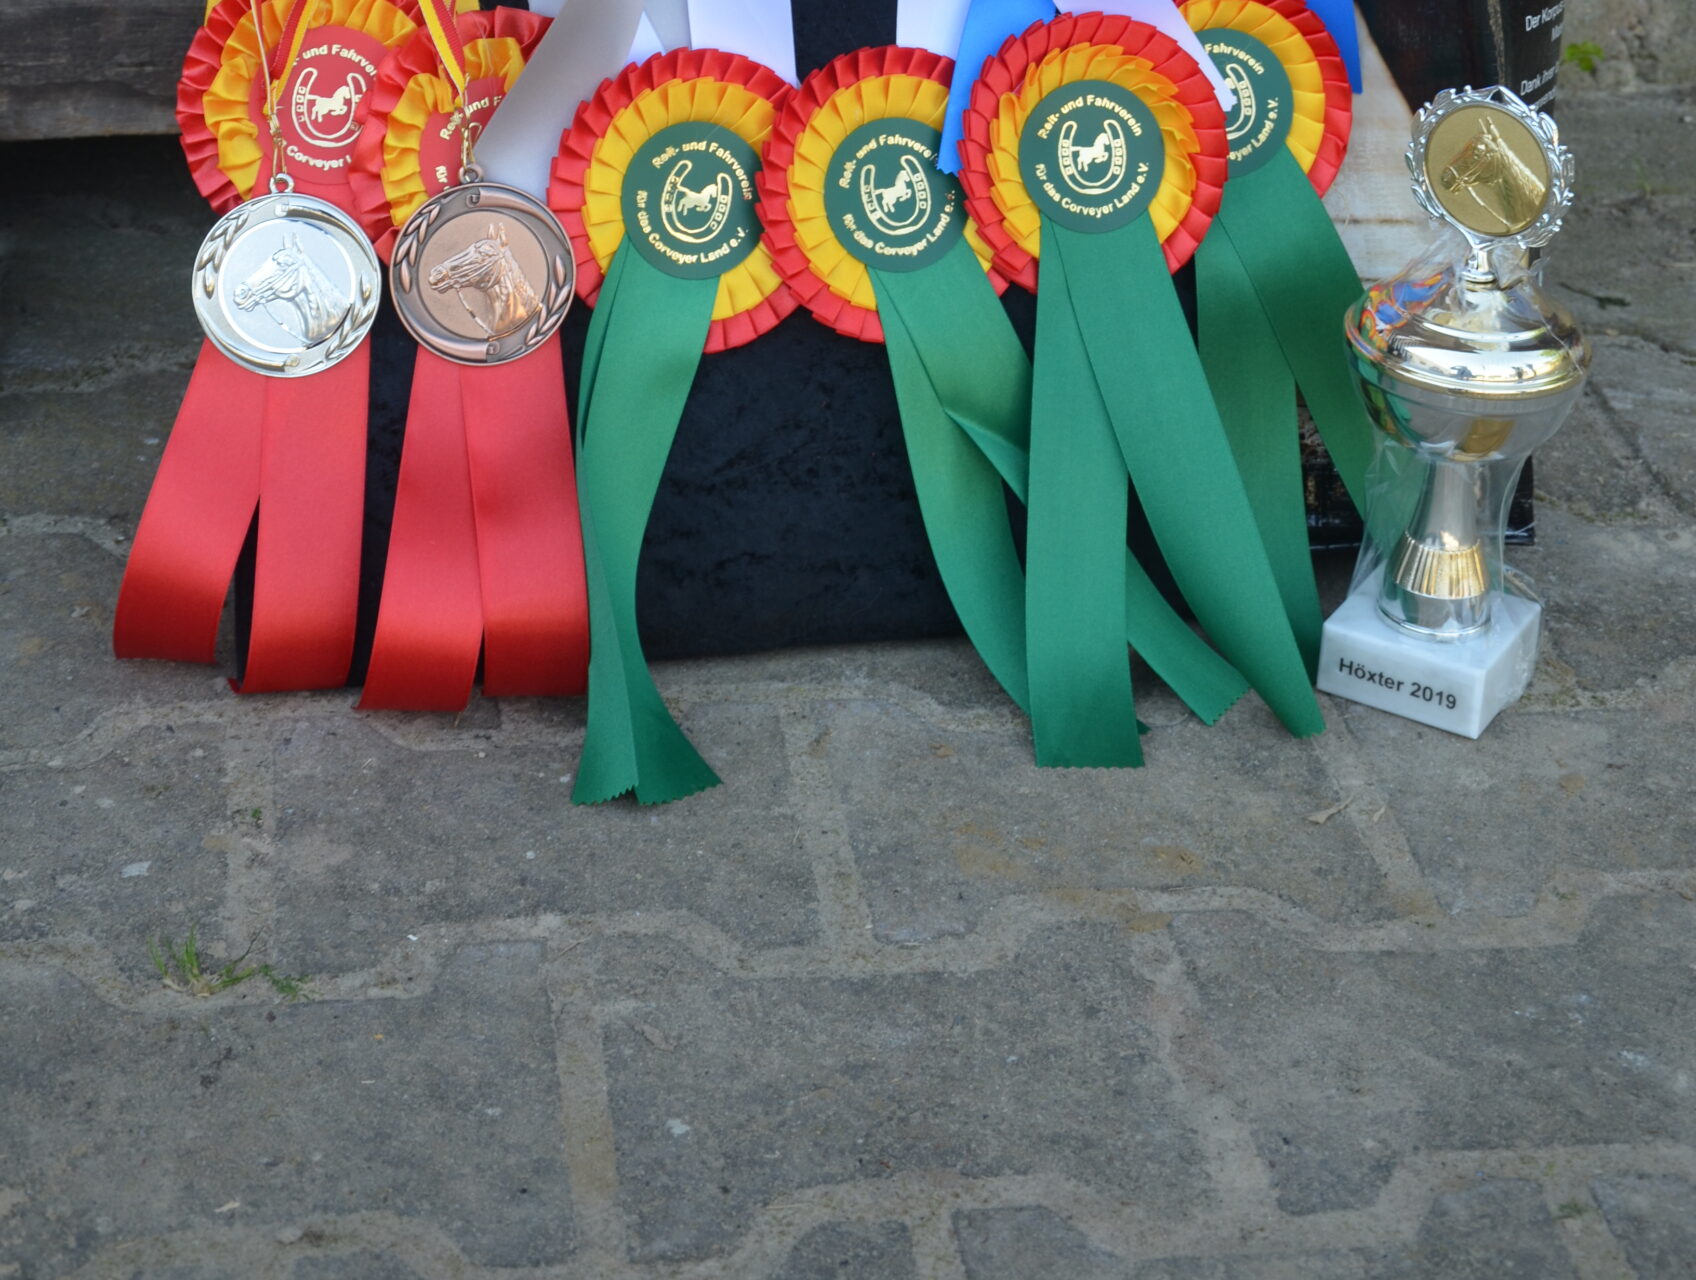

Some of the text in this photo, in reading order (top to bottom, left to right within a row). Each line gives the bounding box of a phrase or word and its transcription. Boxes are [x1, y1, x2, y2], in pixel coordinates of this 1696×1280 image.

[1525, 15, 1541, 31] Der
[303, 45, 328, 59] und
[1204, 43, 1264, 75] Fahrverein
[465, 97, 489, 115] und
[1037, 95, 1143, 140] Reit- und Fahrverein
[1251, 120, 1274, 148] Land
[287, 145, 344, 171] Corveyer
[856, 139, 878, 159] und
[682, 141, 707, 151] und
[709, 142, 753, 200] Fahrverein
[637, 190, 648, 208] für
[1035, 163, 1047, 181] für
[1043, 184, 1060, 202] das
[1061, 197, 1114, 218] Corveyer
[1114, 183, 1140, 208] Land
[637, 211, 651, 234] das
[854, 230, 873, 249] das
[875, 239, 928, 257] Corveyer
[926, 213, 950, 243] Land
[649, 233, 698, 264] Corveyer
[700, 243, 730, 263] Land
[1339, 658, 1457, 710] Höxter 2019
